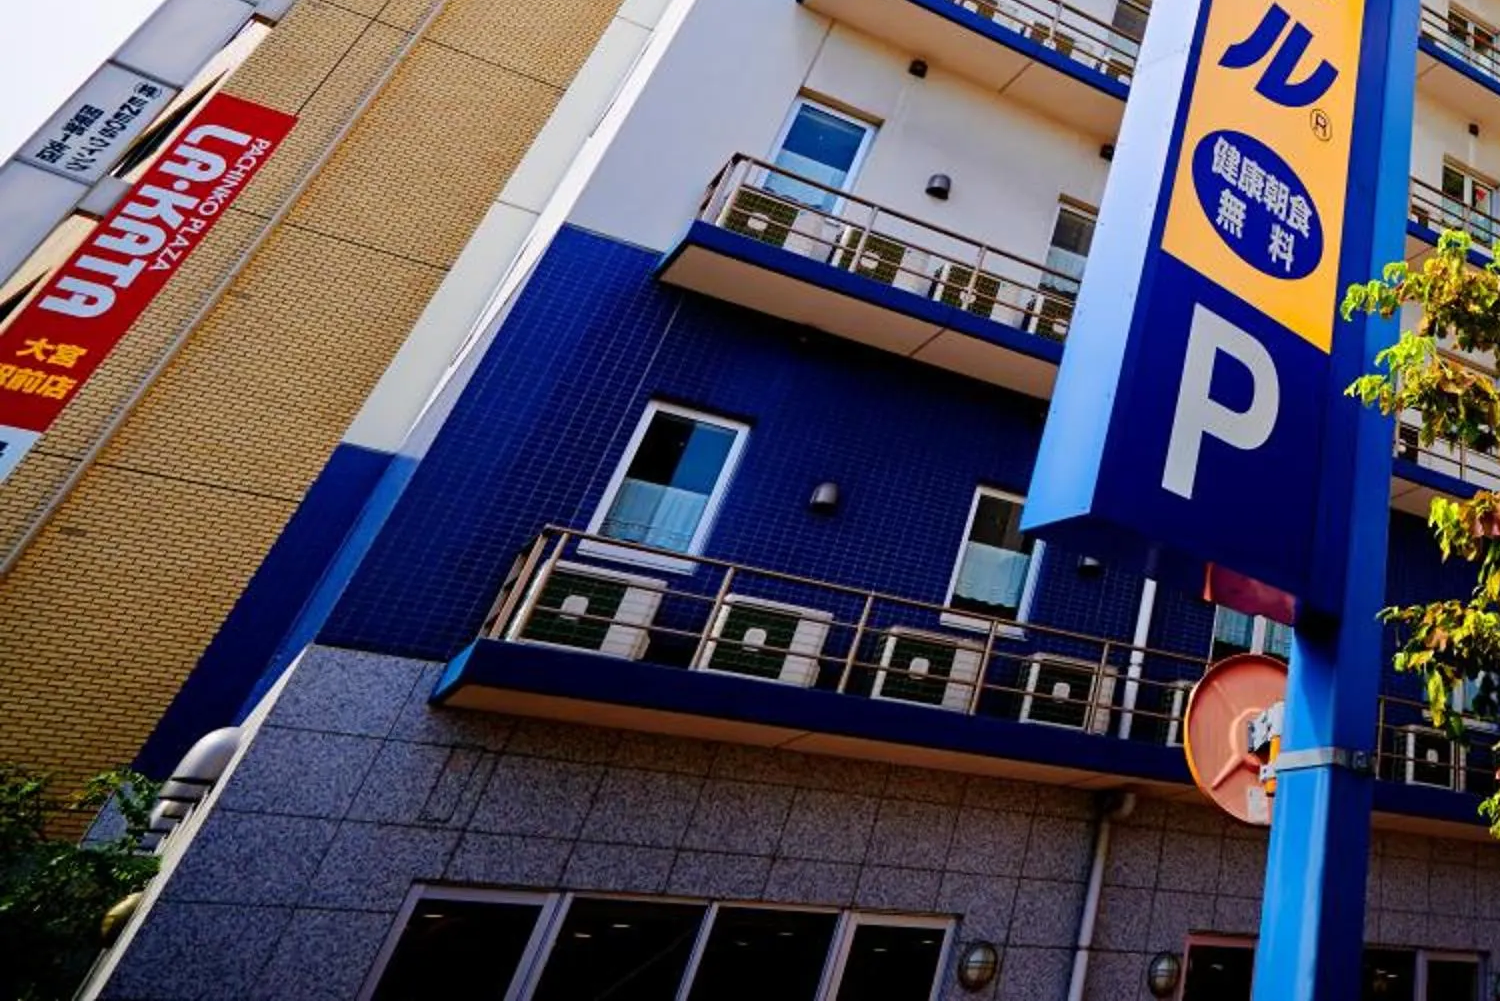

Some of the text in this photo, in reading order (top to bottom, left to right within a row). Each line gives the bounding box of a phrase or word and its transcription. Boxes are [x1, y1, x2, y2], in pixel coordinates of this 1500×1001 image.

[149, 137, 272, 271] PACHINKO PLAZA
[1211, 135, 1314, 239] 健康朝食
[16, 338, 88, 368] 大宮
[1161, 303, 1280, 499] P
